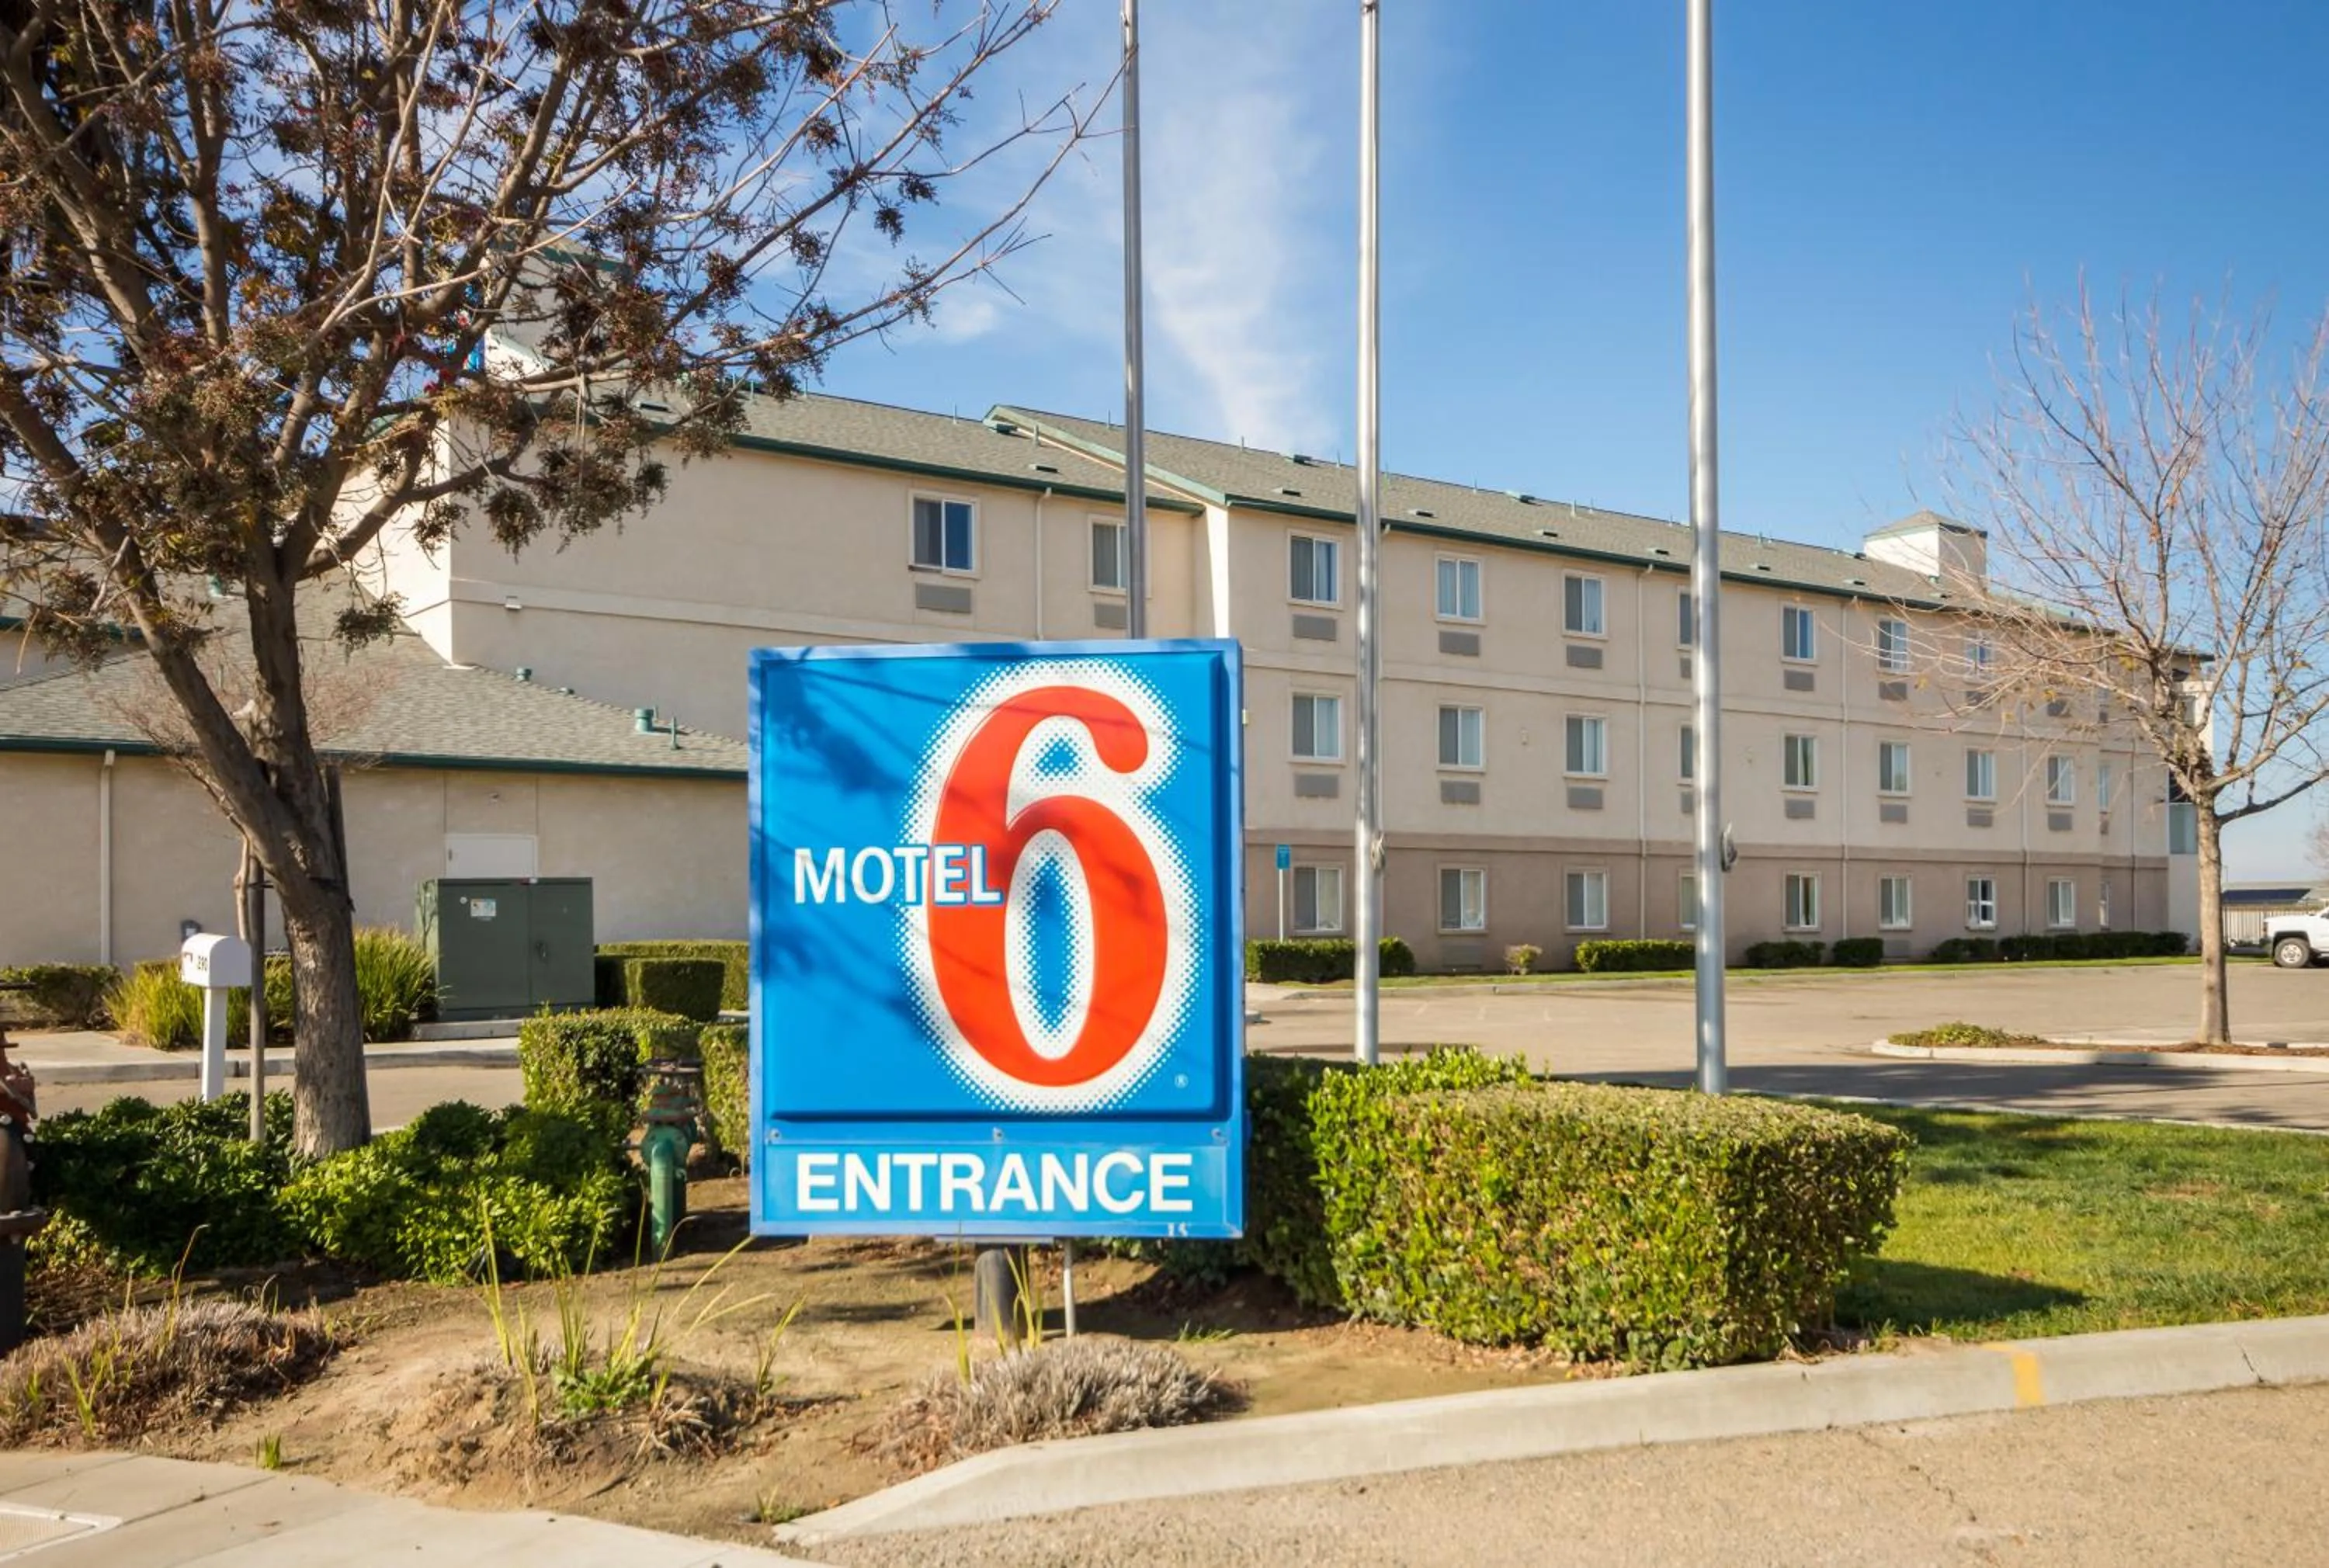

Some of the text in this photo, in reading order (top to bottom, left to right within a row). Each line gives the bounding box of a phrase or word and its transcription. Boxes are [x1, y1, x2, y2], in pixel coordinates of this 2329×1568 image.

[794, 685, 1168, 1088] MOTEL 6
[797, 1152, 1193, 1213] ENTRANCE
